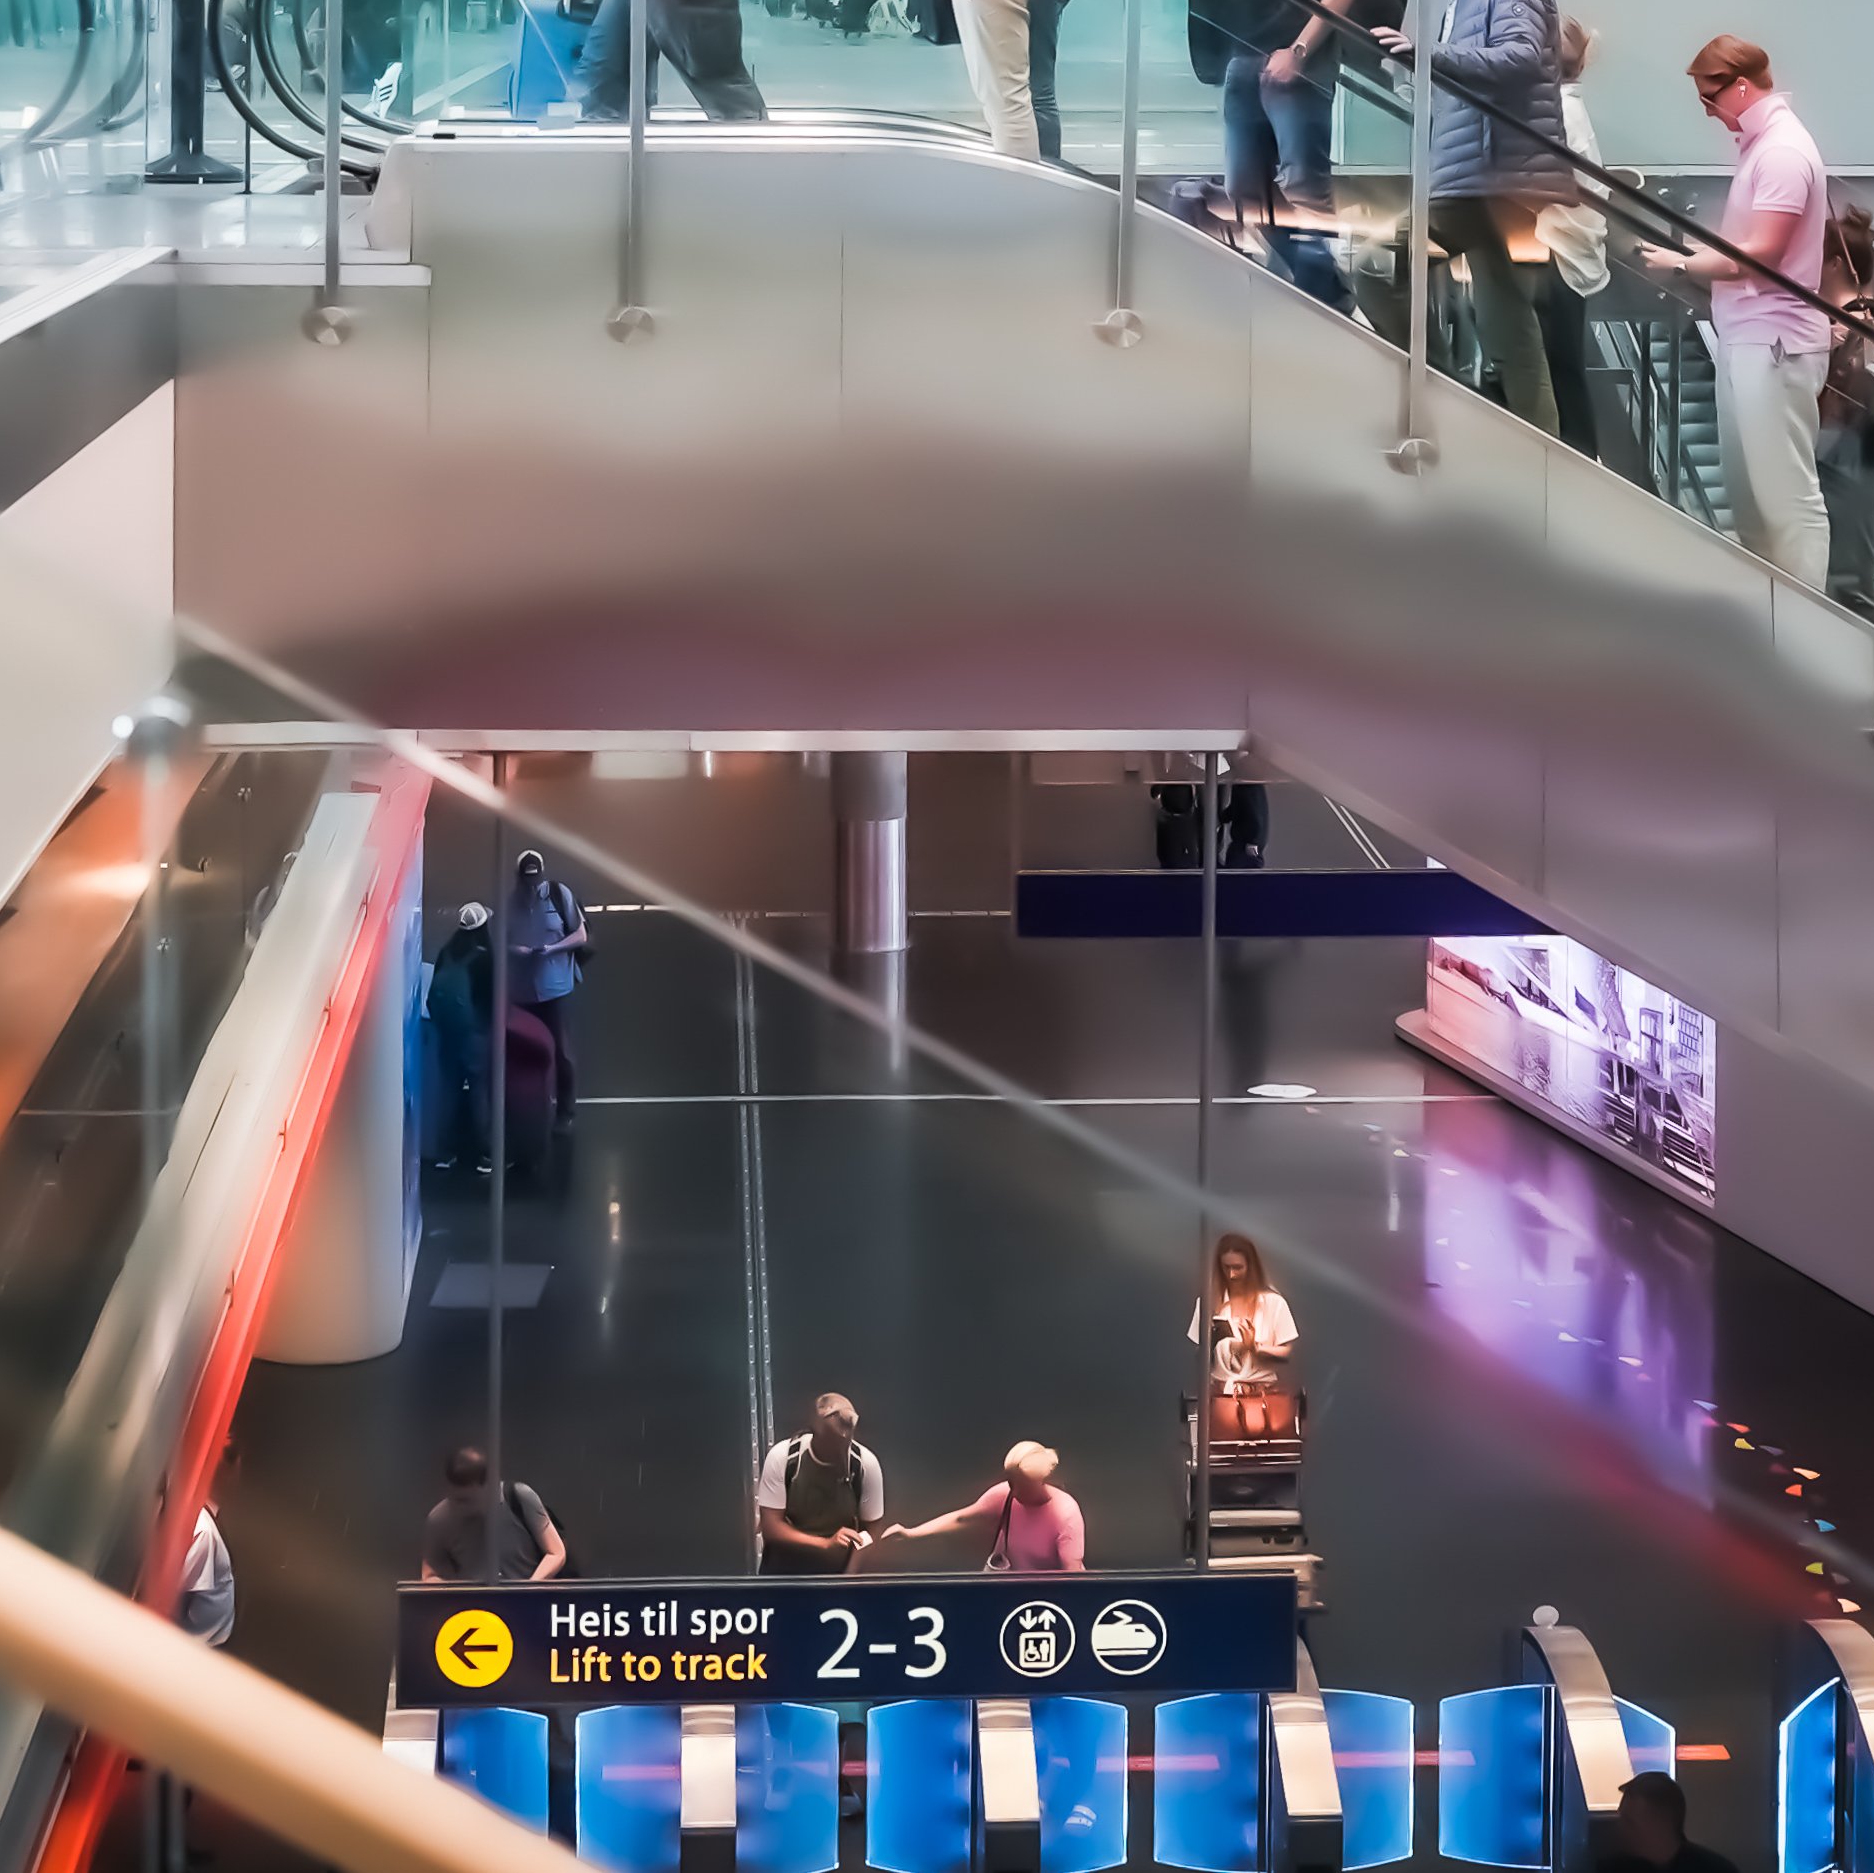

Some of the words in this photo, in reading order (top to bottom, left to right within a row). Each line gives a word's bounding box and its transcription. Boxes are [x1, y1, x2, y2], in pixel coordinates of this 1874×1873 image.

[550, 1603, 630, 1638] Heis
[640, 1600, 678, 1637] til
[690, 1607, 775, 1644] spor
[816, 1606, 948, 1679] 2-3
[550, 1645, 612, 1683] Lift
[621, 1651, 662, 1682] to
[671, 1643, 768, 1682] track
